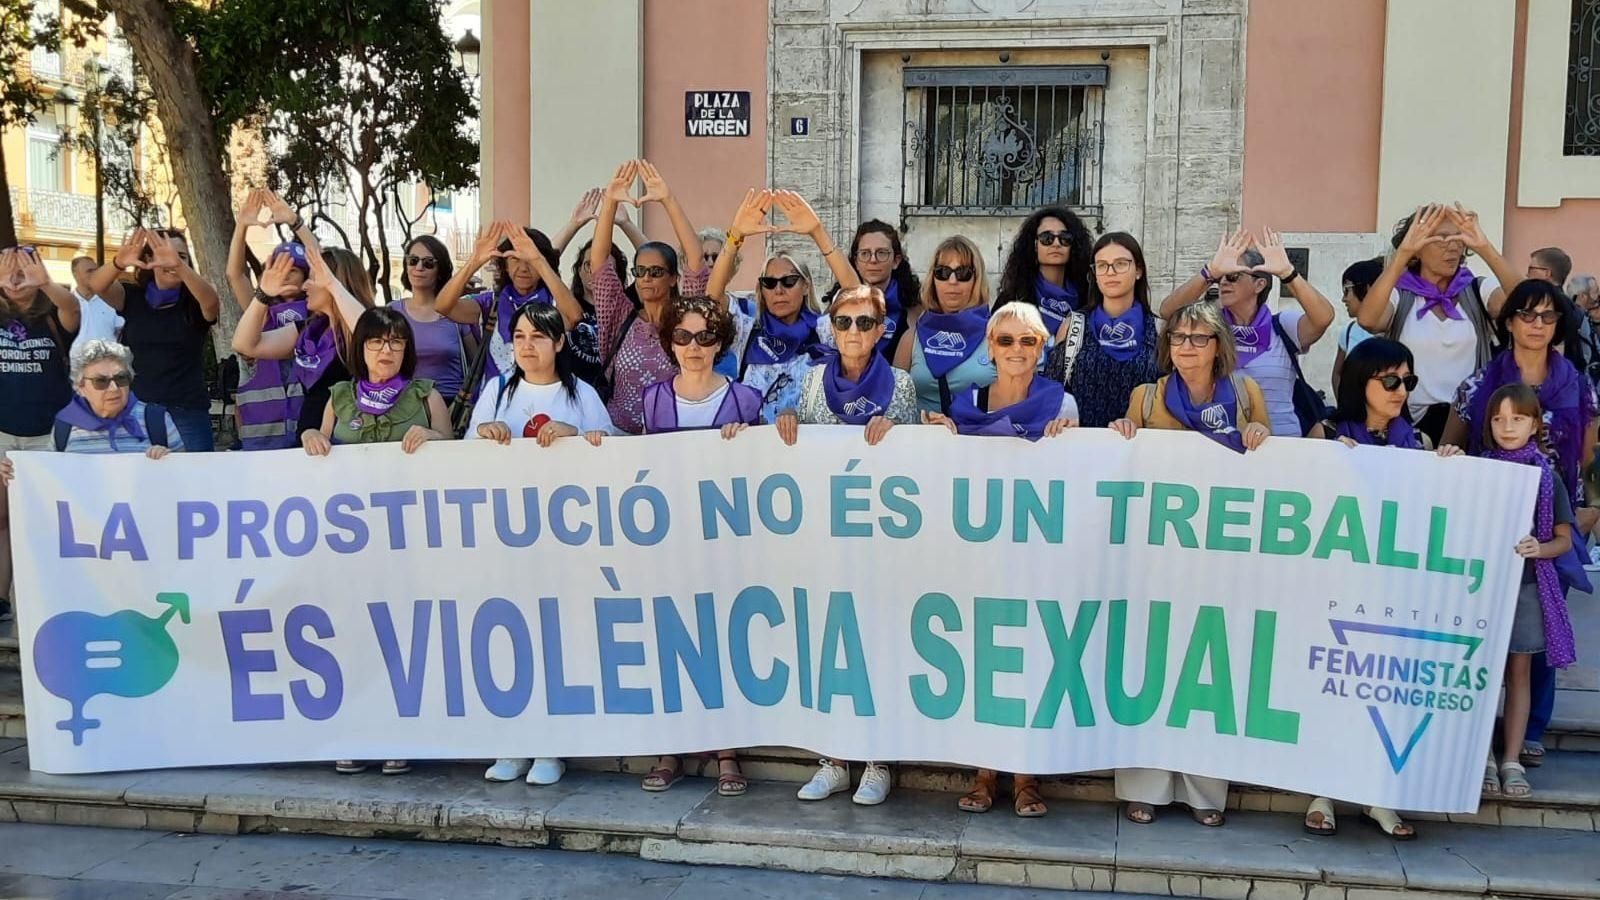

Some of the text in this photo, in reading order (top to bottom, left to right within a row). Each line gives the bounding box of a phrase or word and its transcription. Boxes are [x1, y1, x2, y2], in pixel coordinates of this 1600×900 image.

[694, 93, 740, 108] PLAZA
[688, 119, 747, 135] VIRGEN
[701, 109, 734, 119] DE LA
[795, 119, 804, 133] 6
[1068, 321, 1080, 347] LOLA
[33, 349, 50, 360] SOY
[57, 459, 1486, 594] LA PROSTITUCIÓ NO ÉS UN TREBALL,
[1328, 600, 1488, 630] PARTIDO
[218, 566, 1300, 744] ÉS VIOLÈNCIA SEXUAL
[1308, 645, 1488, 692] FEMINISTAS
[1321, 677, 1474, 712] AL CONGRESO
